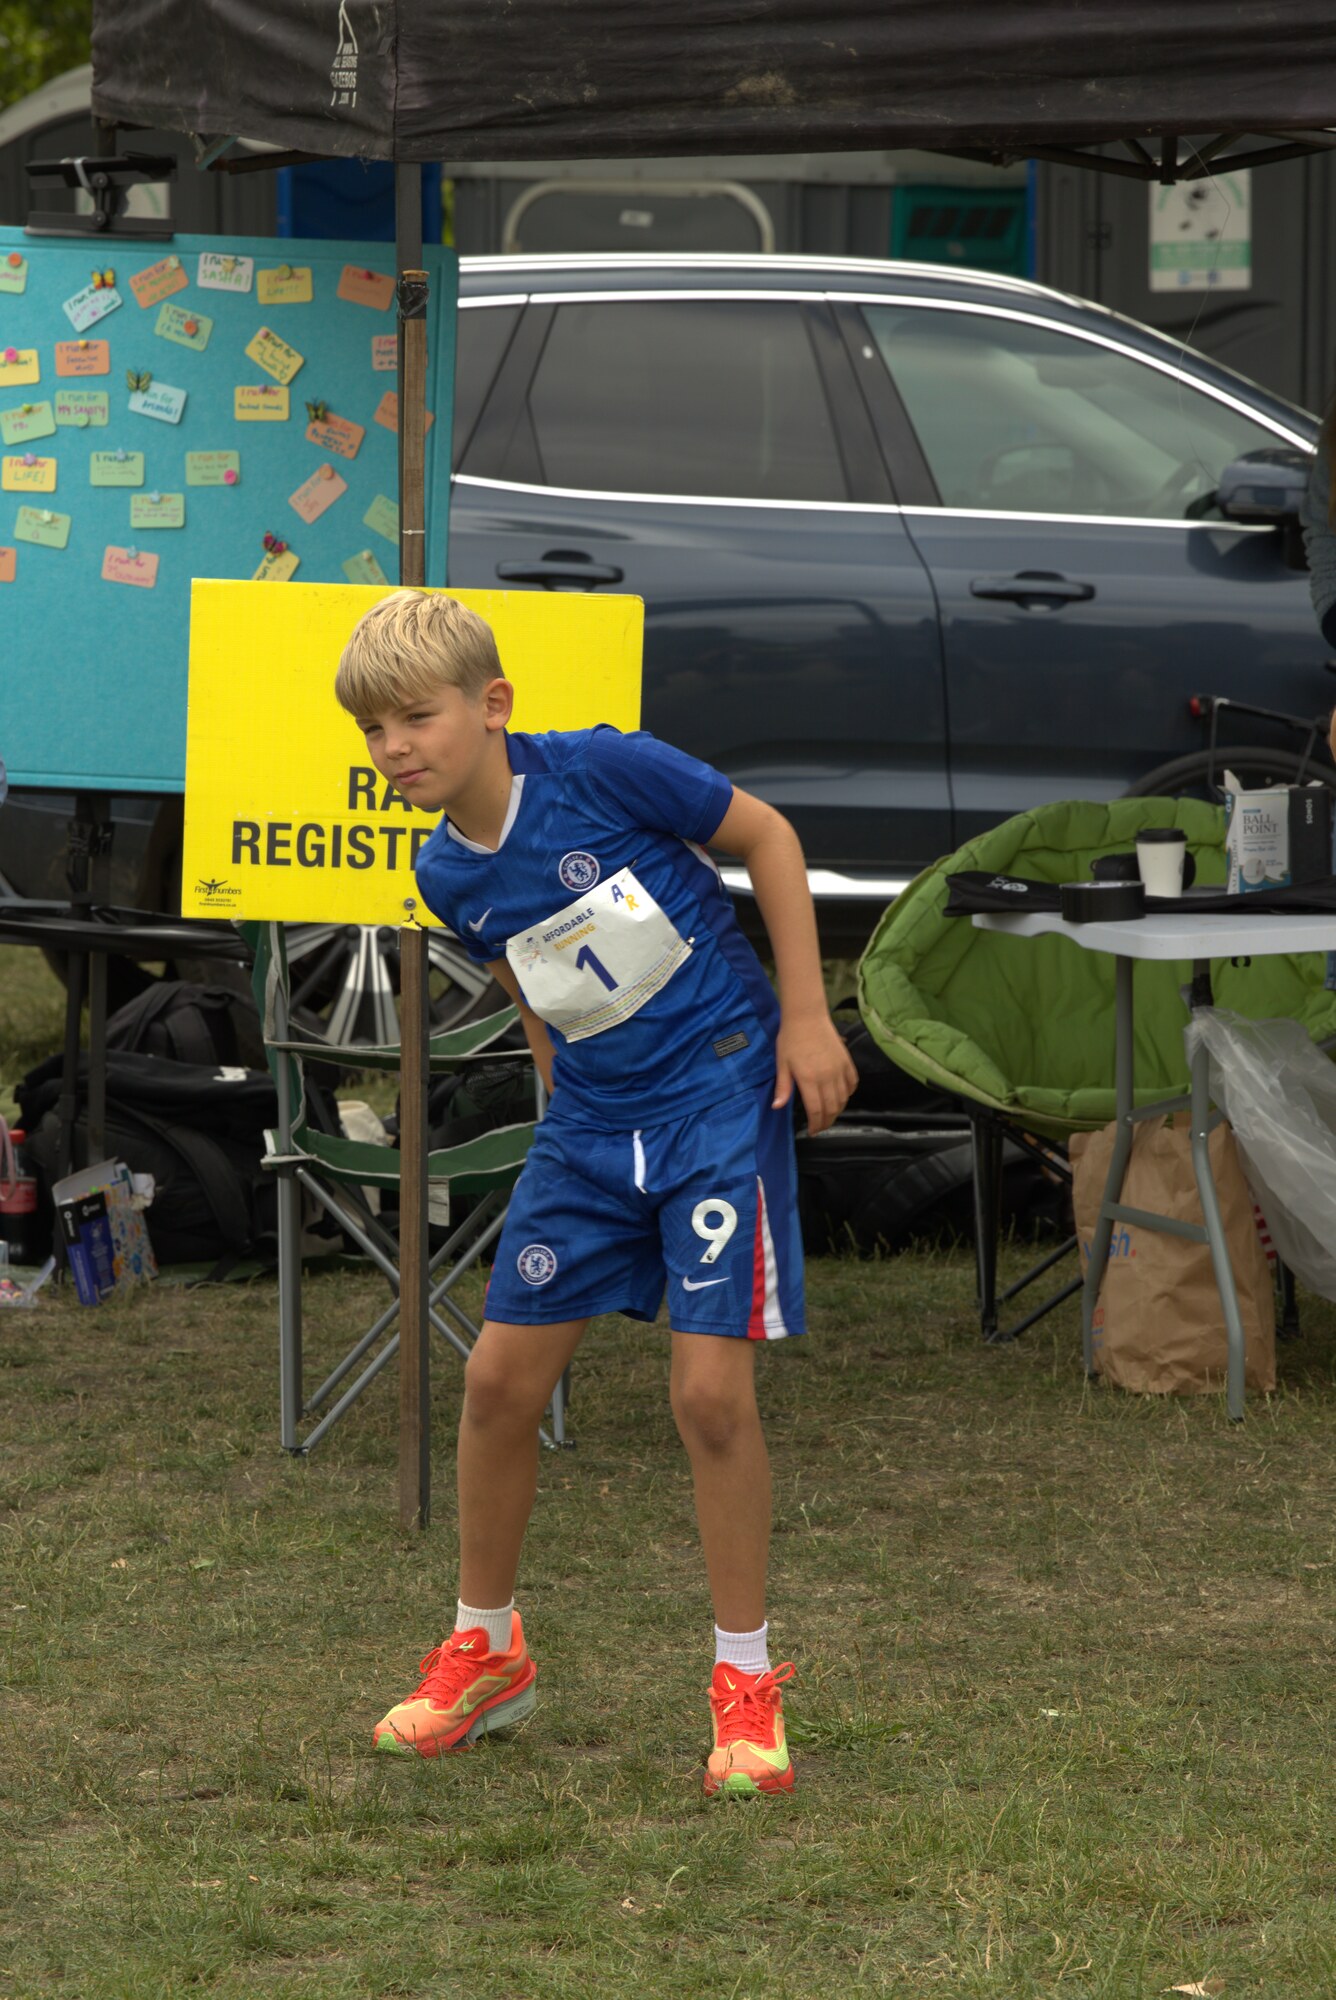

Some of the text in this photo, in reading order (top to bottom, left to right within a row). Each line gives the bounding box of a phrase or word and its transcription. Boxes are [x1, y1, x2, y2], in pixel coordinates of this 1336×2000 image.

[348, 766, 444, 813] RA
[1243, 814, 1273, 825] BALL
[1305, 798, 1313, 825] SONOS
[1243, 823, 1279, 834] POINT
[542, 907, 595, 943] AFFORDABLE
[553, 922, 596, 951] RUNNING
[575, 944, 619, 992] 1
[691, 1198, 738, 1264] 9
